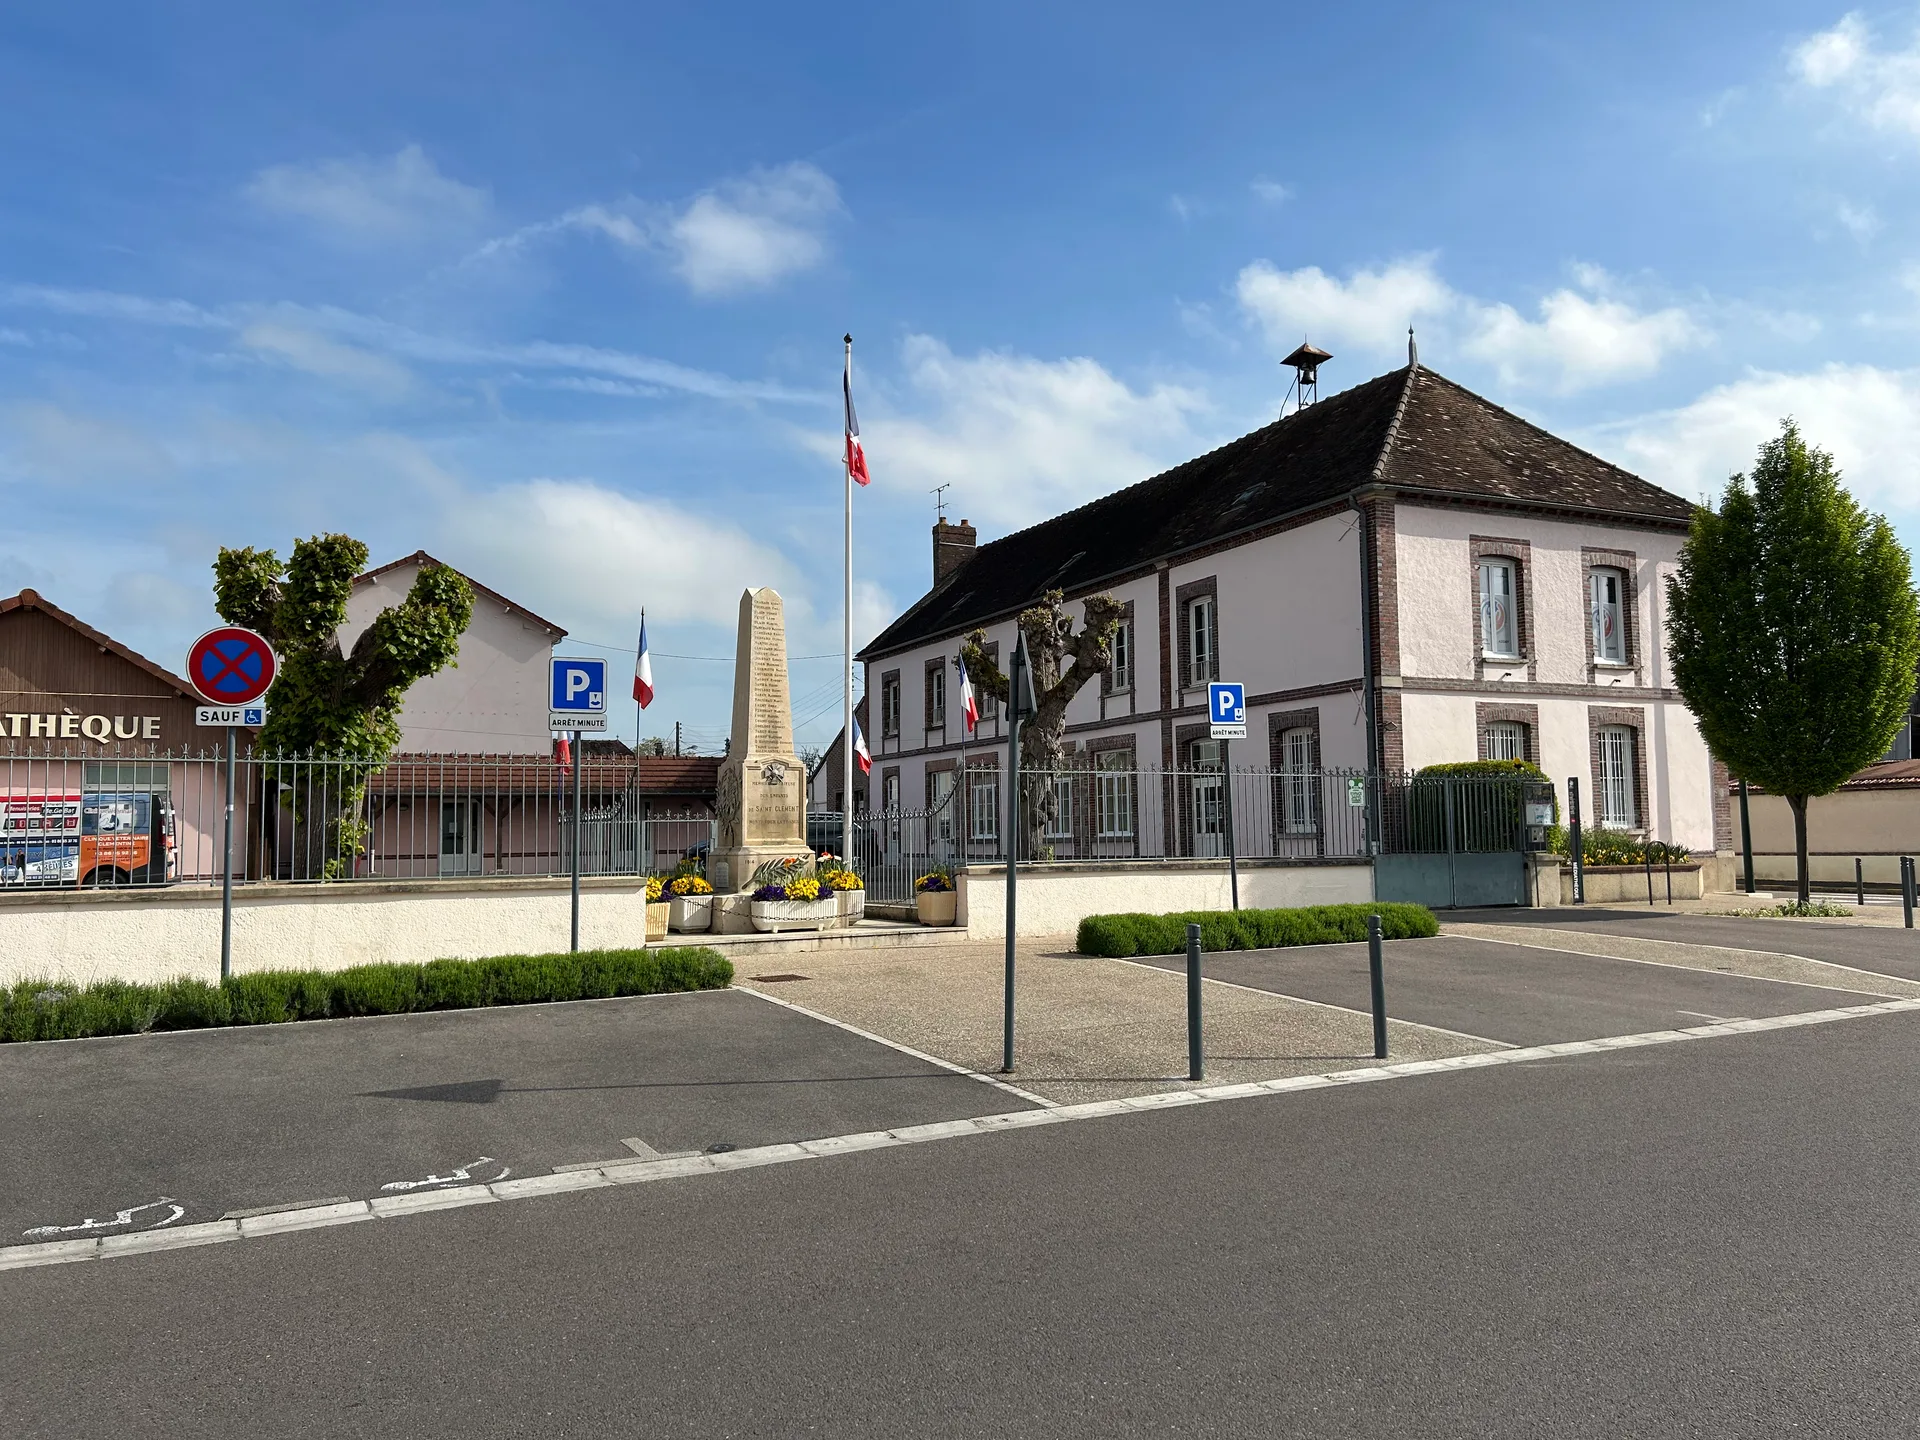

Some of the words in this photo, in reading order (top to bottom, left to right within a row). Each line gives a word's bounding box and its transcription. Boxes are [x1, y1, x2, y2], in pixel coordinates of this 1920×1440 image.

[566, 669, 590, 700] P
[1219, 691, 1234, 715] P
[200, 710, 240, 722] SAUF
[552, 718, 576, 726] ARRÊT
